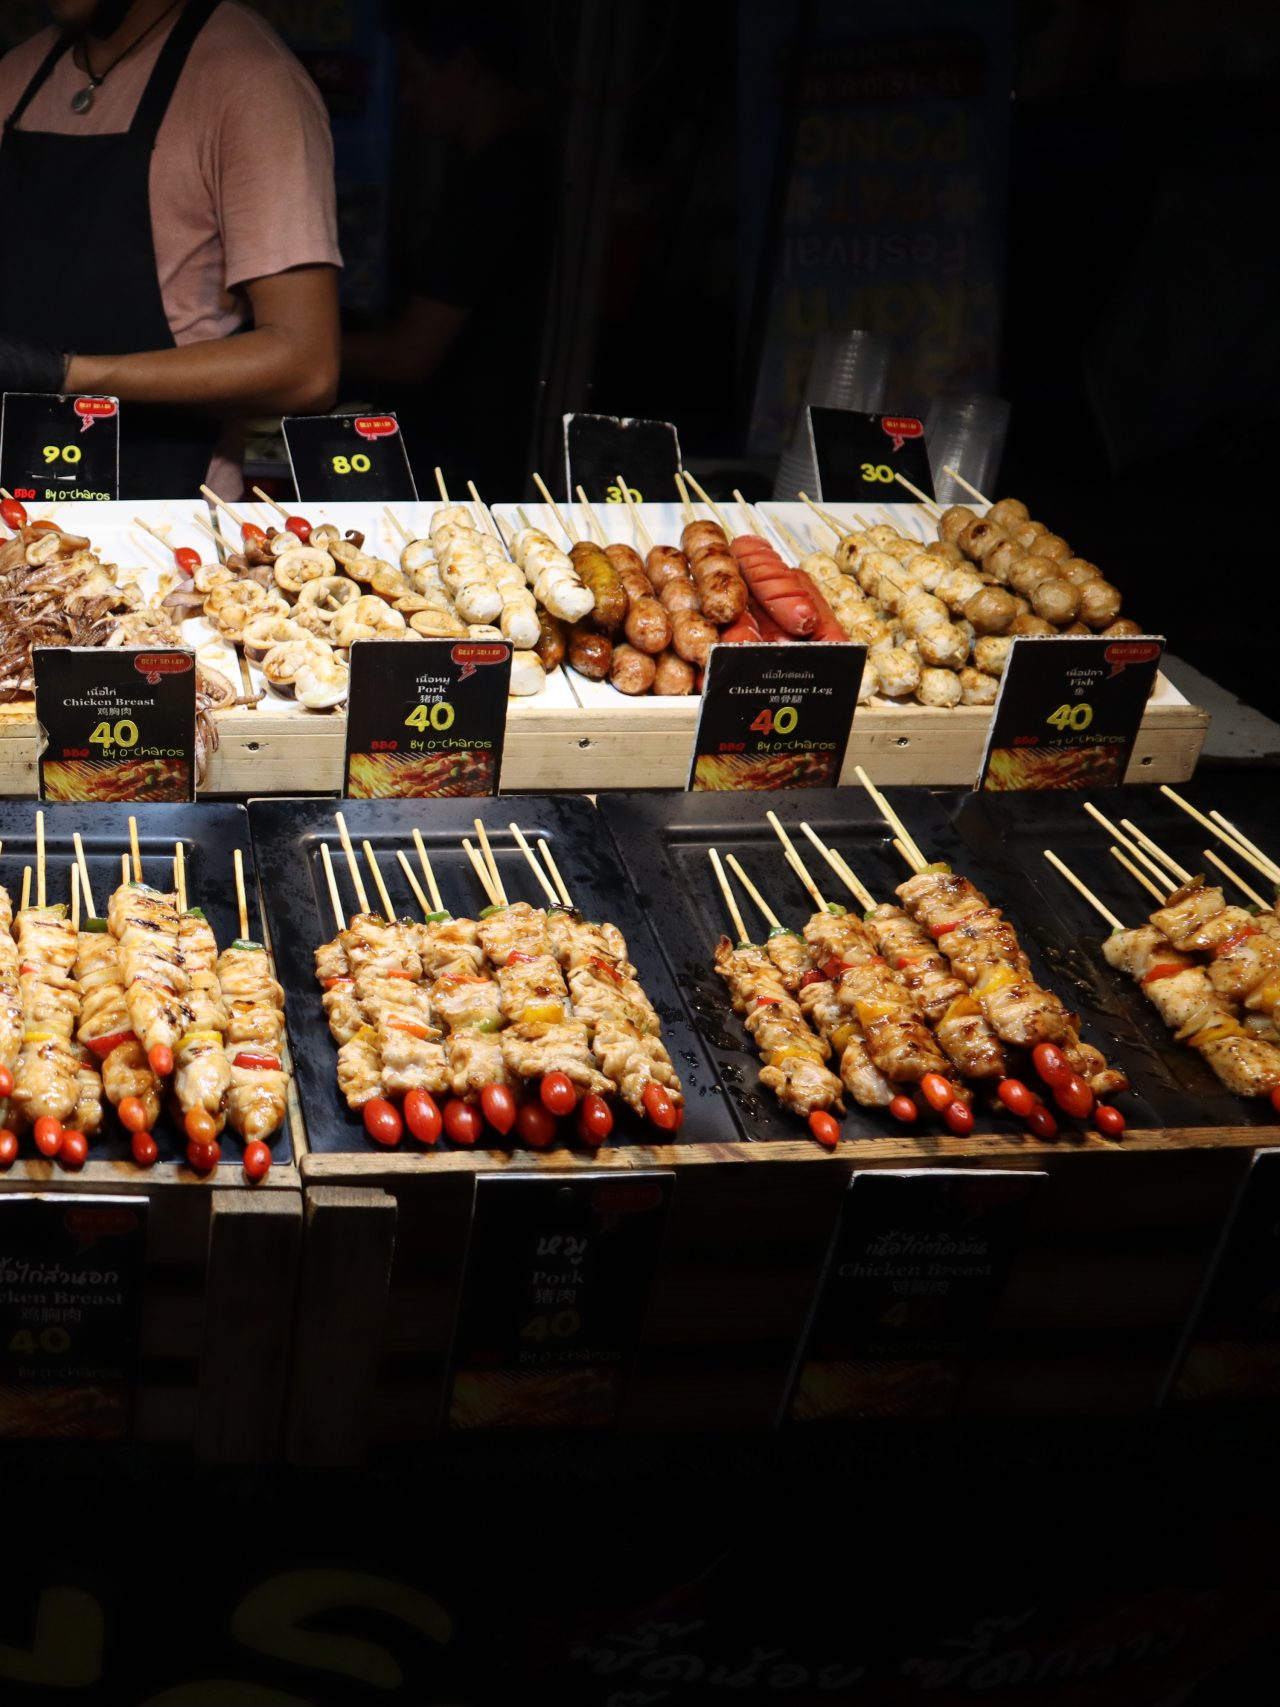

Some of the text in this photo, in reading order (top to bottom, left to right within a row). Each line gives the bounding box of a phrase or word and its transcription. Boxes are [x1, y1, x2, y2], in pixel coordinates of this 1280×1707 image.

[42, 445, 82, 463] 90
[332, 454, 371, 474] 80
[860, 463, 895, 483] 30
[14, 488, 36, 499] BBQ
[45, 489, 56, 501] By
[417, 685, 447, 694] Pork
[729, 686, 833, 696] Chicken Bone Leg
[1070, 678, 1094, 687] Fish
[62, 698, 155, 707] Chicken Breast
[420, 695, 443, 704] 猪肉
[404, 702, 455, 733] 40
[749, 706, 798, 736] 40
[1046, 703, 1093, 731] 40
[88, 719, 139, 749] 40
[410, 740, 424, 751] By
[536, 1235, 588, 1265] หมู
[532, 1269, 584, 1285] Pork
[839, 1261, 993, 1277] Chicken Breast
[53, 1291, 123, 1305] Breast
[521, 1310, 581, 1342] 40
[7, 1326, 72, 1354] 40
